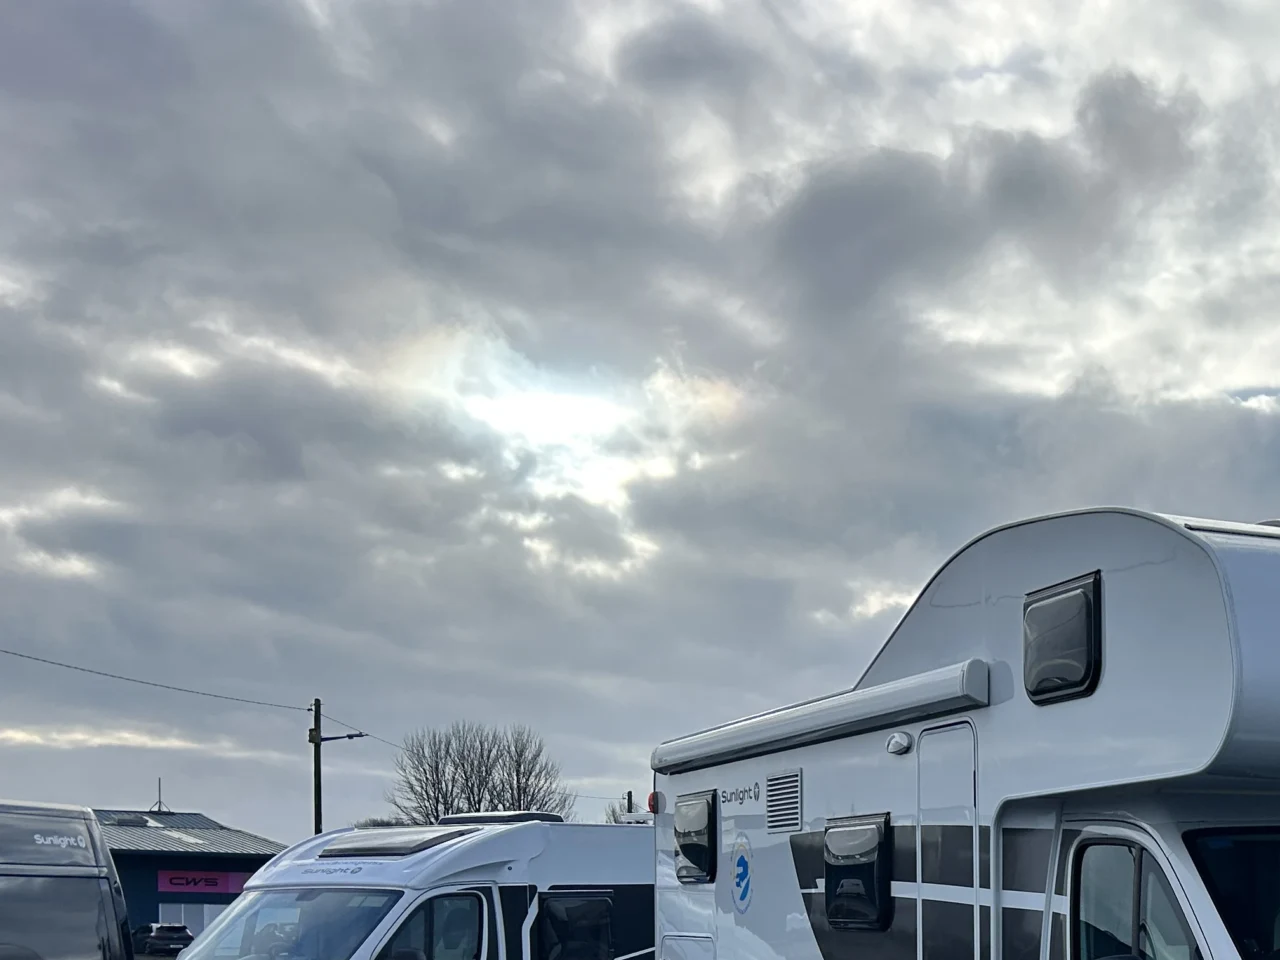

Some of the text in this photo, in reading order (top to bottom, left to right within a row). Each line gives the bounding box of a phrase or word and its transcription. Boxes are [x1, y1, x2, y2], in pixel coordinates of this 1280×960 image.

[721, 786, 753, 805] Sunlight
[33, 833, 78, 848] Sunlight
[168, 876, 219, 887] CWS
